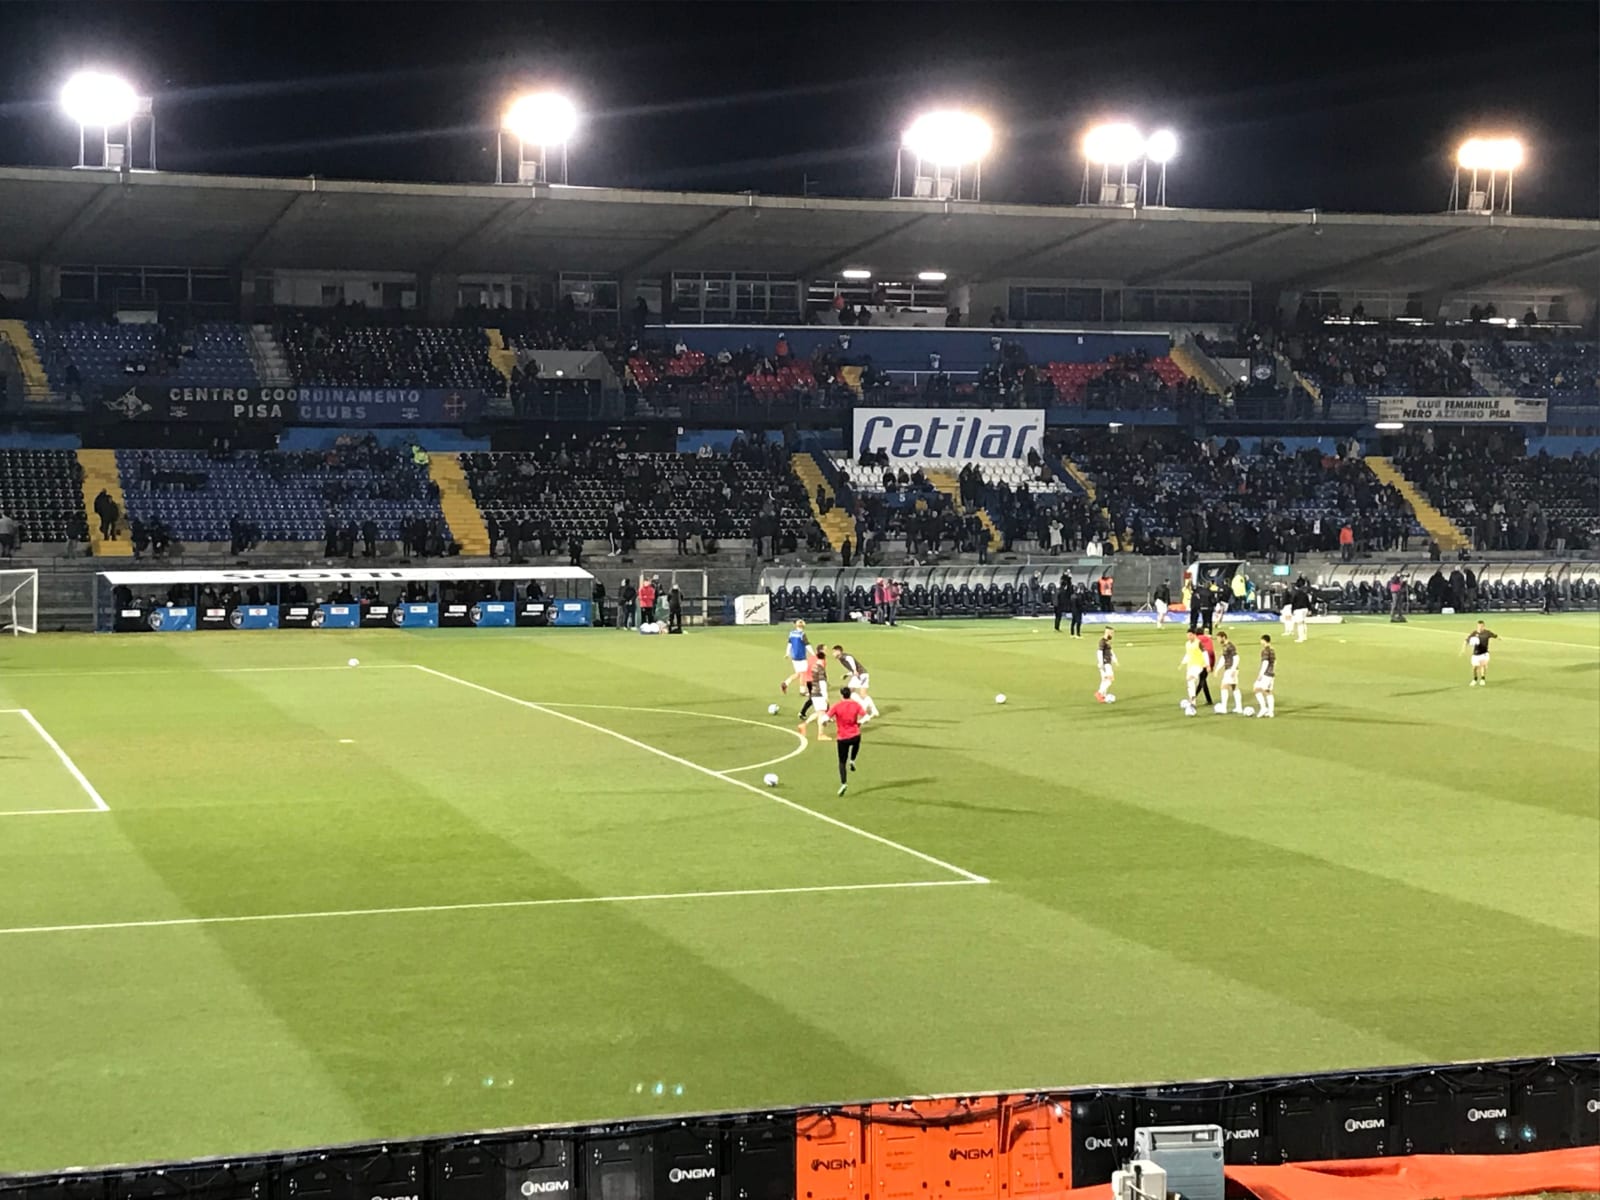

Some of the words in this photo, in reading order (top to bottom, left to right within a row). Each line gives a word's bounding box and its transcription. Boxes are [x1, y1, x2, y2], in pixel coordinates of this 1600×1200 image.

[169, 388, 249, 401] CENTRO
[260, 388, 420, 403] COORDINAMENTO
[1416, 400, 1441, 409] CLUB
[1445, 400, 1500, 409] FEMMINILE
[234, 404, 282, 418] PISA
[300, 405, 367, 419] CLUBS
[1402, 409, 1432, 419] NERO
[1488, 409, 1511, 418] PISA
[859, 416, 1037, 459] Cetilar
[1478, 1108, 1507, 1120] NGM
[1354, 1118, 1385, 1130] NGM
[1229, 1128, 1259, 1140] NGM
[955, 1147, 994, 1160] NGM
[818, 1158, 857, 1171] NGM
[681, 1167, 716, 1180] NGM
[533, 1180, 569, 1193] NGM
